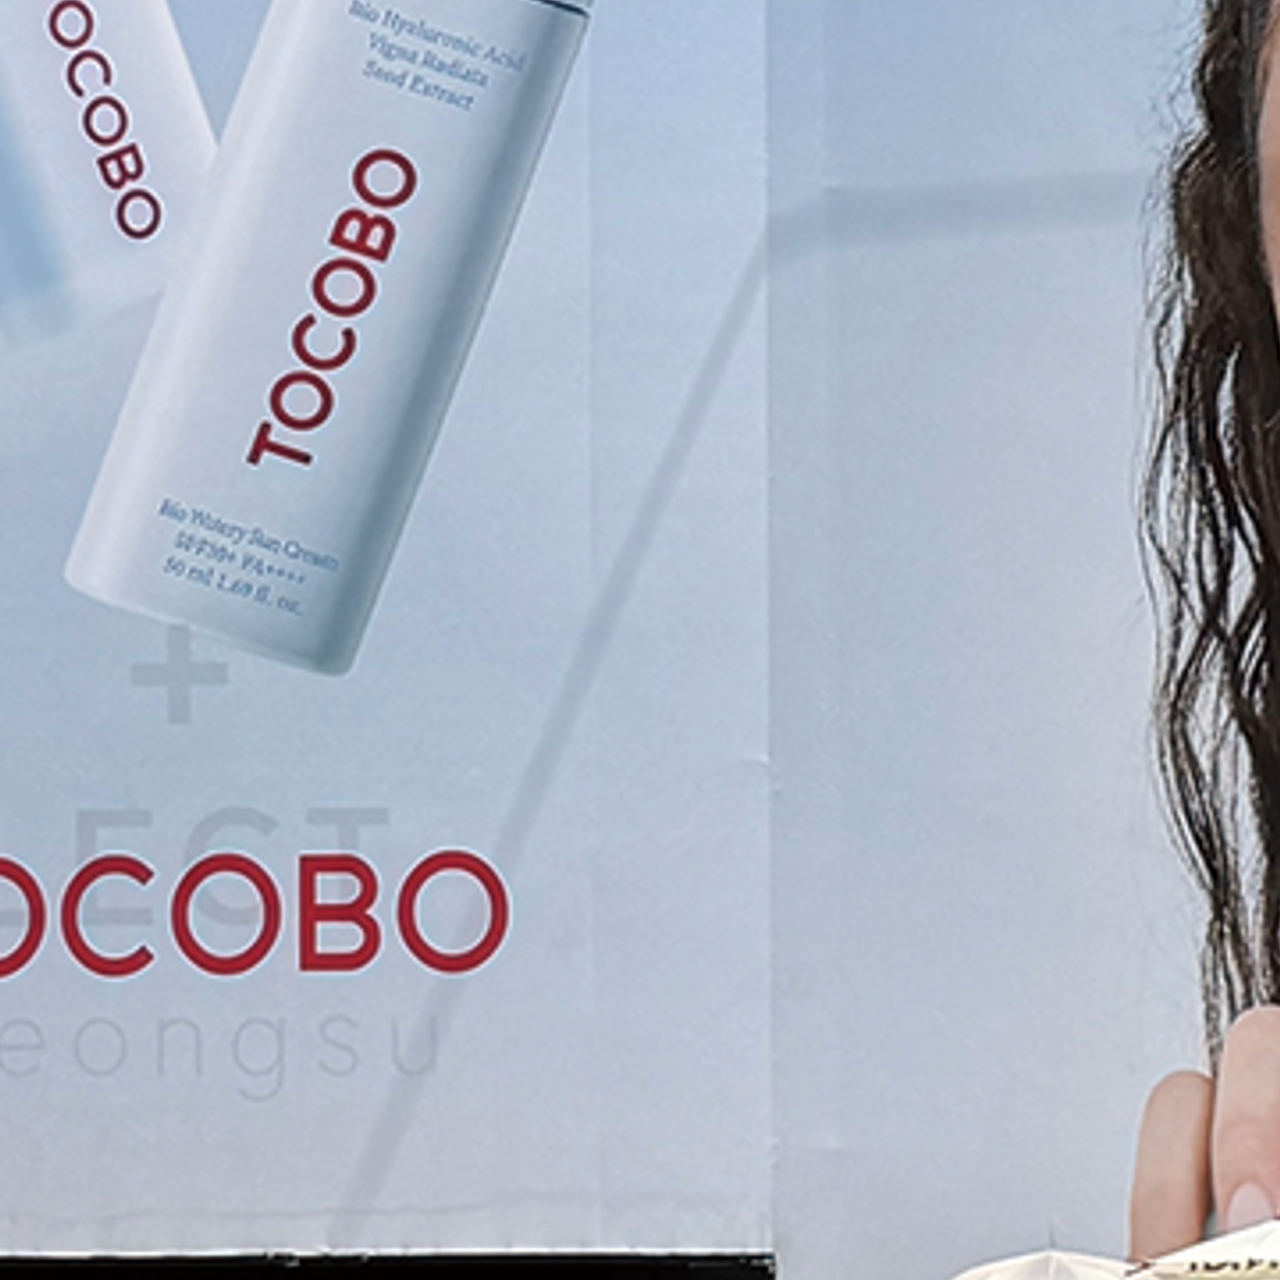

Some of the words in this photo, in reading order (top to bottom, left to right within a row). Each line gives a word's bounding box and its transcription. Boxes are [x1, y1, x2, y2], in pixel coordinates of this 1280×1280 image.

[382, 10, 483, 58] Hyaluronic
[363, 60, 407, 89] Seed
[409, 75, 475, 111] Extract
[246, 148, 418, 467] TOCOBO
[248, 528, 281, 552] Sun
